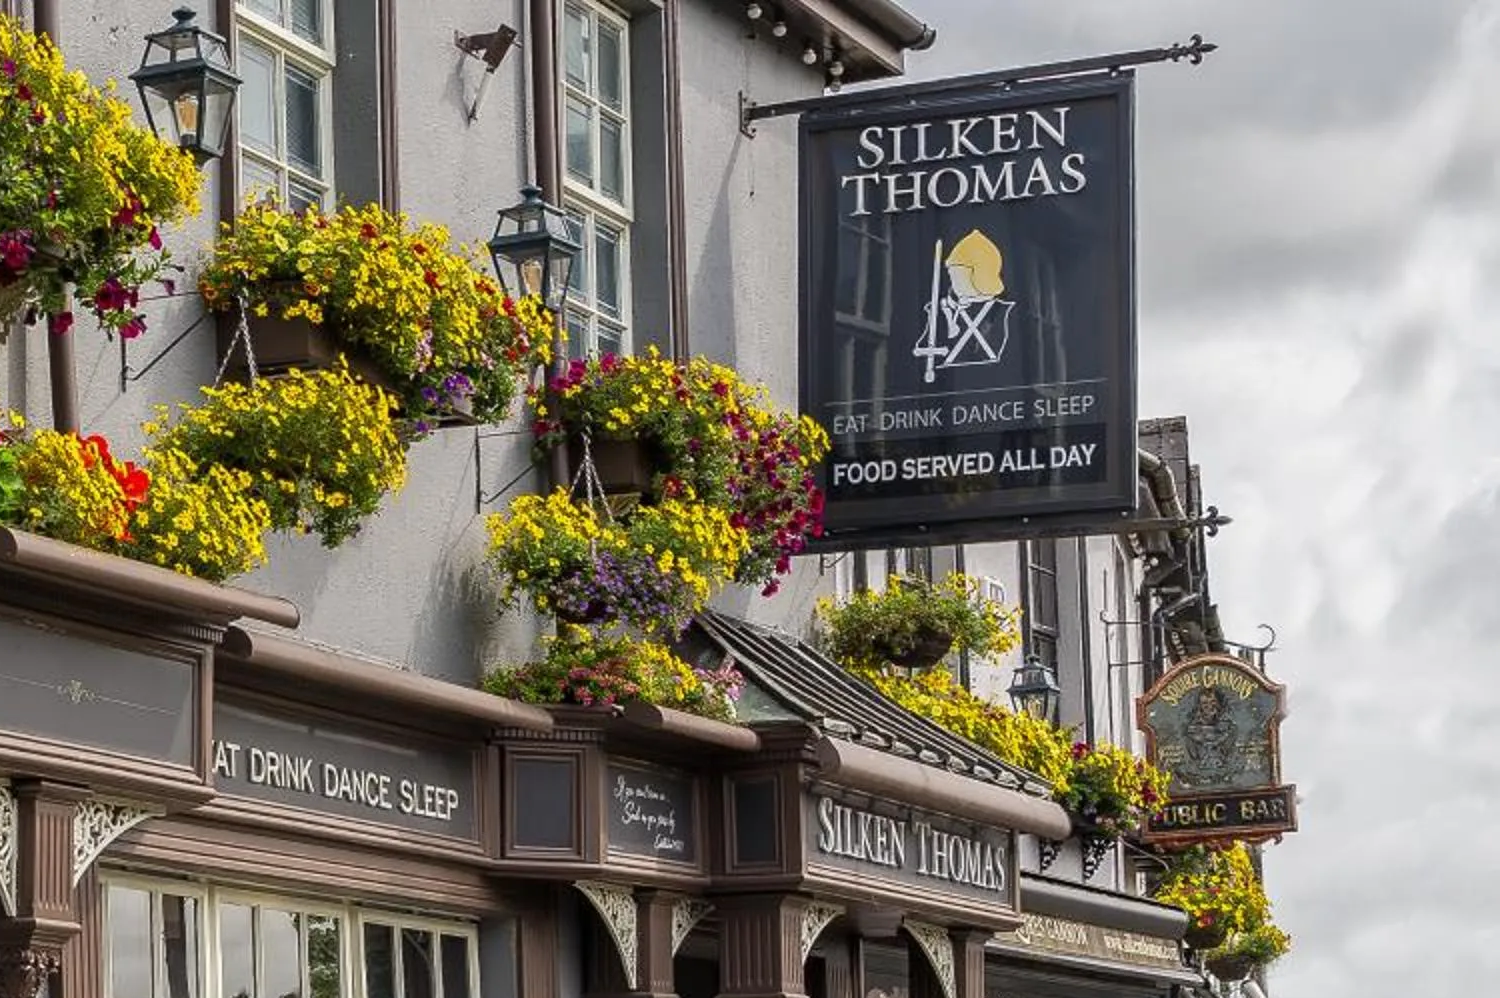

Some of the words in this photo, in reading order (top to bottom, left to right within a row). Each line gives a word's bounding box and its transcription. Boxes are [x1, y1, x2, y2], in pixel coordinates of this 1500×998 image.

[857, 107, 1071, 169] SILKEN
[841, 153, 1087, 217] THOMAS
[833, 414, 869, 436] EAT
[880, 409, 943, 432] DRINK
[953, 401, 1025, 426] DANCE
[1034, 395, 1095, 419] SLEEP
[833, 460, 896, 486] FOOD
[902, 452, 994, 481] SERVED
[999, 447, 1045, 473] ALL
[1051, 444, 1097, 469] DAY
[211, 739, 241, 777] AT
[251, 747, 315, 793] DRINK
[325, 763, 392, 810] DANCE
[400, 780, 459, 821] SLEEP
[1163, 803, 1228, 826] UBLIC
[1240, 799, 1286, 820] BAR
[818, 797, 905, 867] SILKEN
[913, 821, 1006, 892] THOMAS
